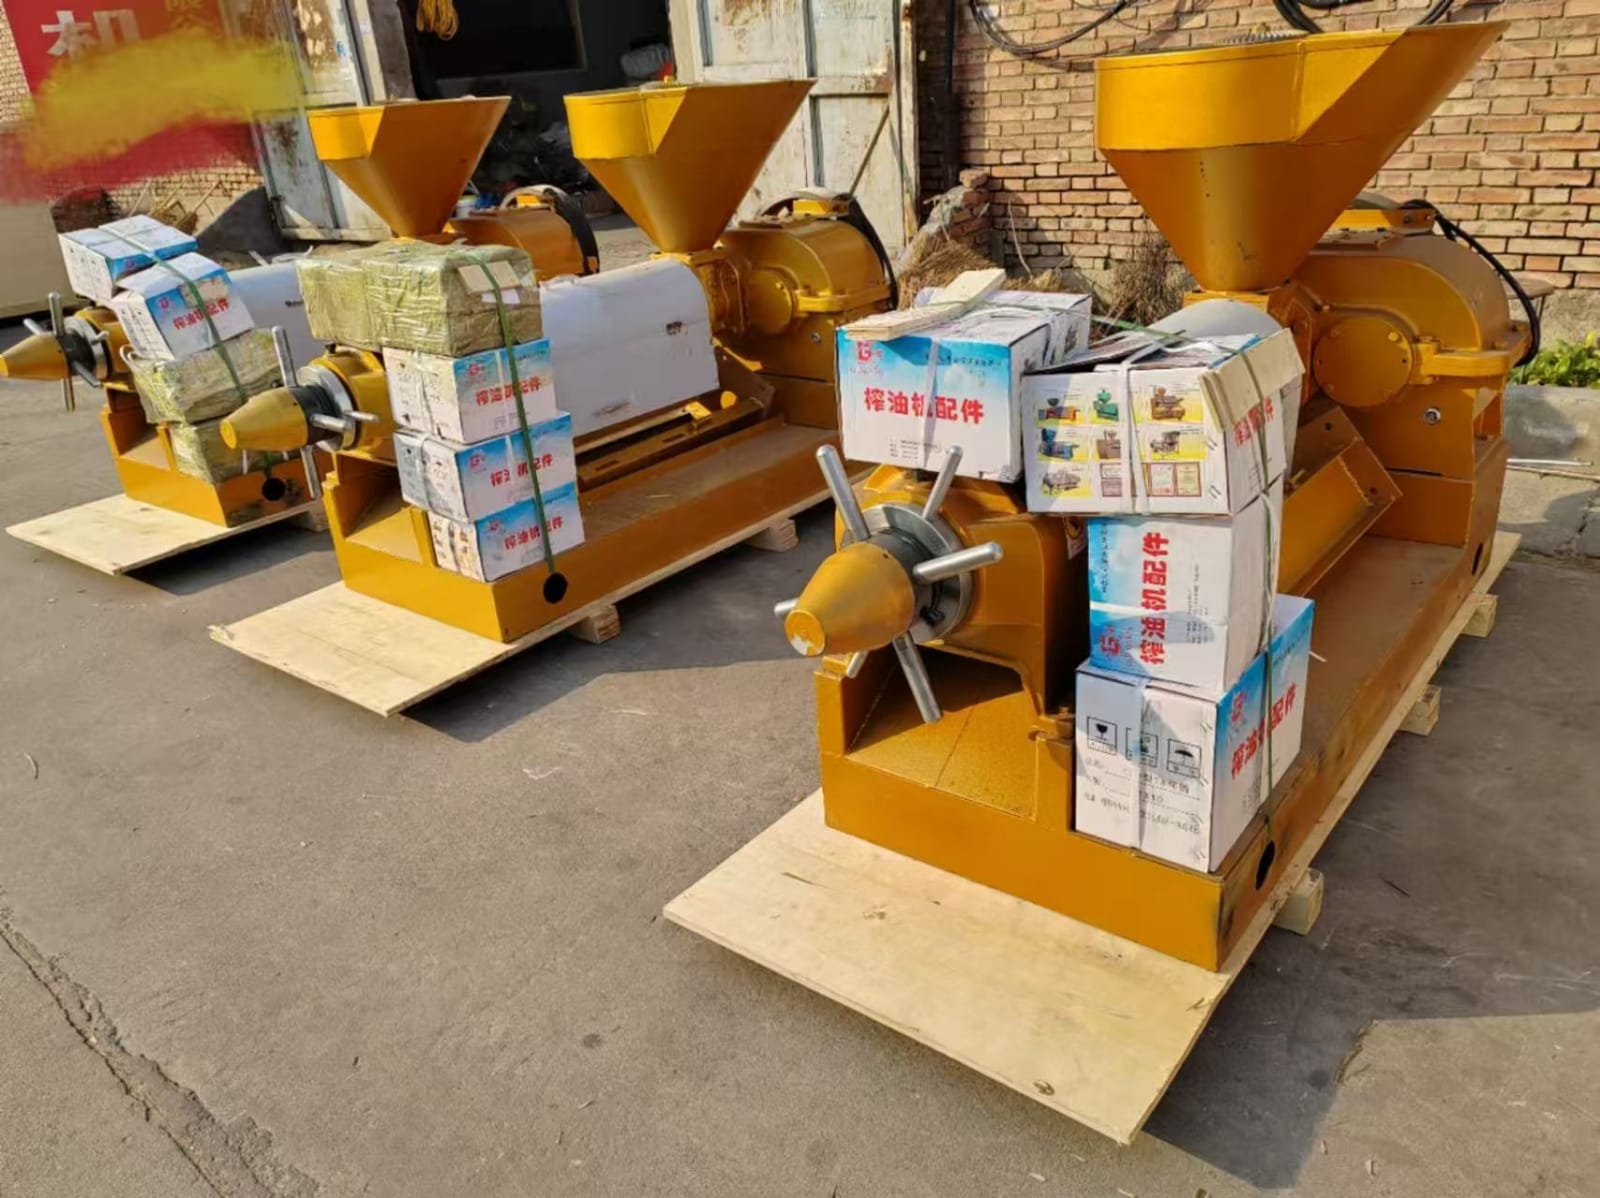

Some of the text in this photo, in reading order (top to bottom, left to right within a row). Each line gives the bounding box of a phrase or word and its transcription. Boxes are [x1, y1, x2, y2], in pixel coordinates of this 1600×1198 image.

[864, 386, 984, 424] 榨油机配件
[1139, 531, 1169, 665] 榨油机配件
